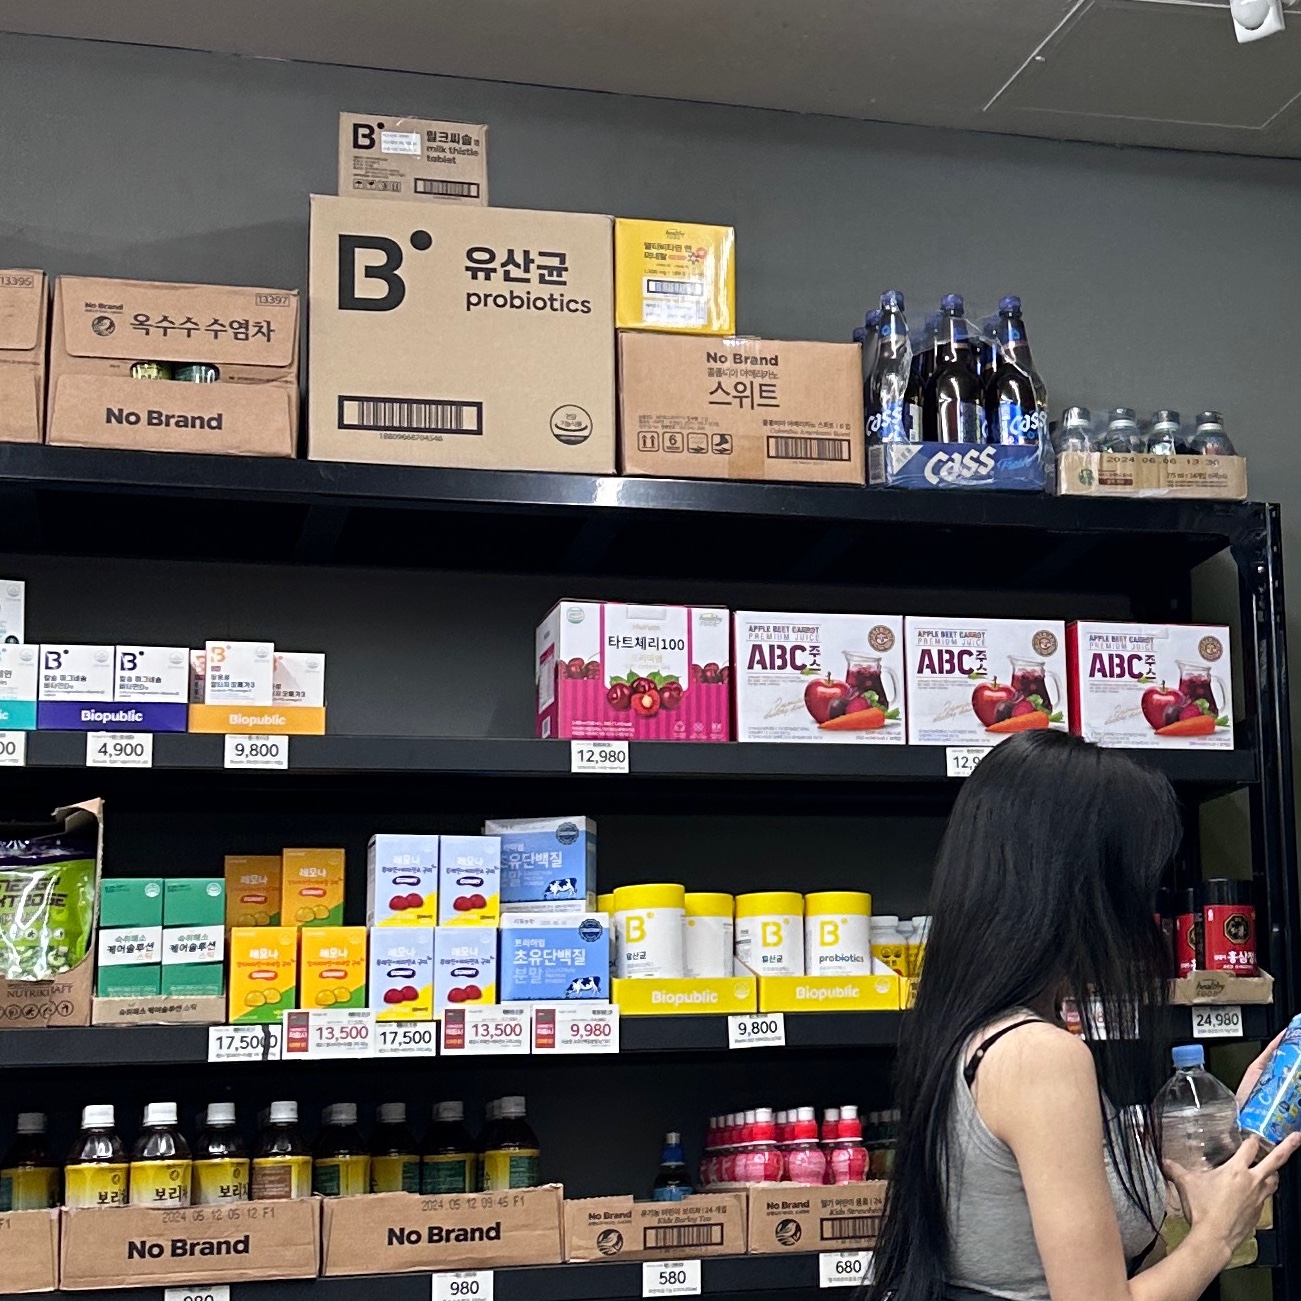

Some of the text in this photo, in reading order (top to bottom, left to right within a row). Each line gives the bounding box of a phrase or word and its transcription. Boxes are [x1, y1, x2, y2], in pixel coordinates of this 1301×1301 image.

[464, 245, 569, 287] 유산균
[466, 288, 592, 315] probiotics
[130, 313, 276, 343] 옥수수 수염차
[706, 351, 779, 366] No Brand
[709, 380, 780, 410] 스위트
[105, 407, 224, 431] No Brand
[608, 635, 685, 652] 타트체리100
[747, 643, 808, 671] ABC
[917, 648, 974, 675] ABC
[1089, 652, 1144, 679] ABC
[81, 709, 143, 723] Biopublic
[228, 713, 286, 727] Biopublic
[97, 742, 144, 758] 4,900
[234, 742, 280, 758] 9,800
[576, 749, 626, 765] 12,980
[513, 947, 587, 967] 초유단백질
[819, 952, 865, 964] probiotics
[651, 990, 719, 1006] Biopublic
[795, 984, 860, 1000] Biopublic
[737, 1020, 779, 1037] 9,800
[1196, 1013, 1240, 1028] 24,980
[315, 1025, 369, 1042] 13,500
[379, 1030, 432, 1048] 17,500
[471, 1022, 523, 1040] 13,500
[570, 1022, 612, 1040] 9,980
[766, 1199, 810, 1211] No Brand
[588, 1210, 632, 1221] No Brand
[387, 1222, 502, 1246] No Brand
[127, 1234, 250, 1260] No Brand
[835, 1259, 862, 1275] 680
[658, 1270, 687, 1286] 580
[449, 1279, 480, 1297] 980
